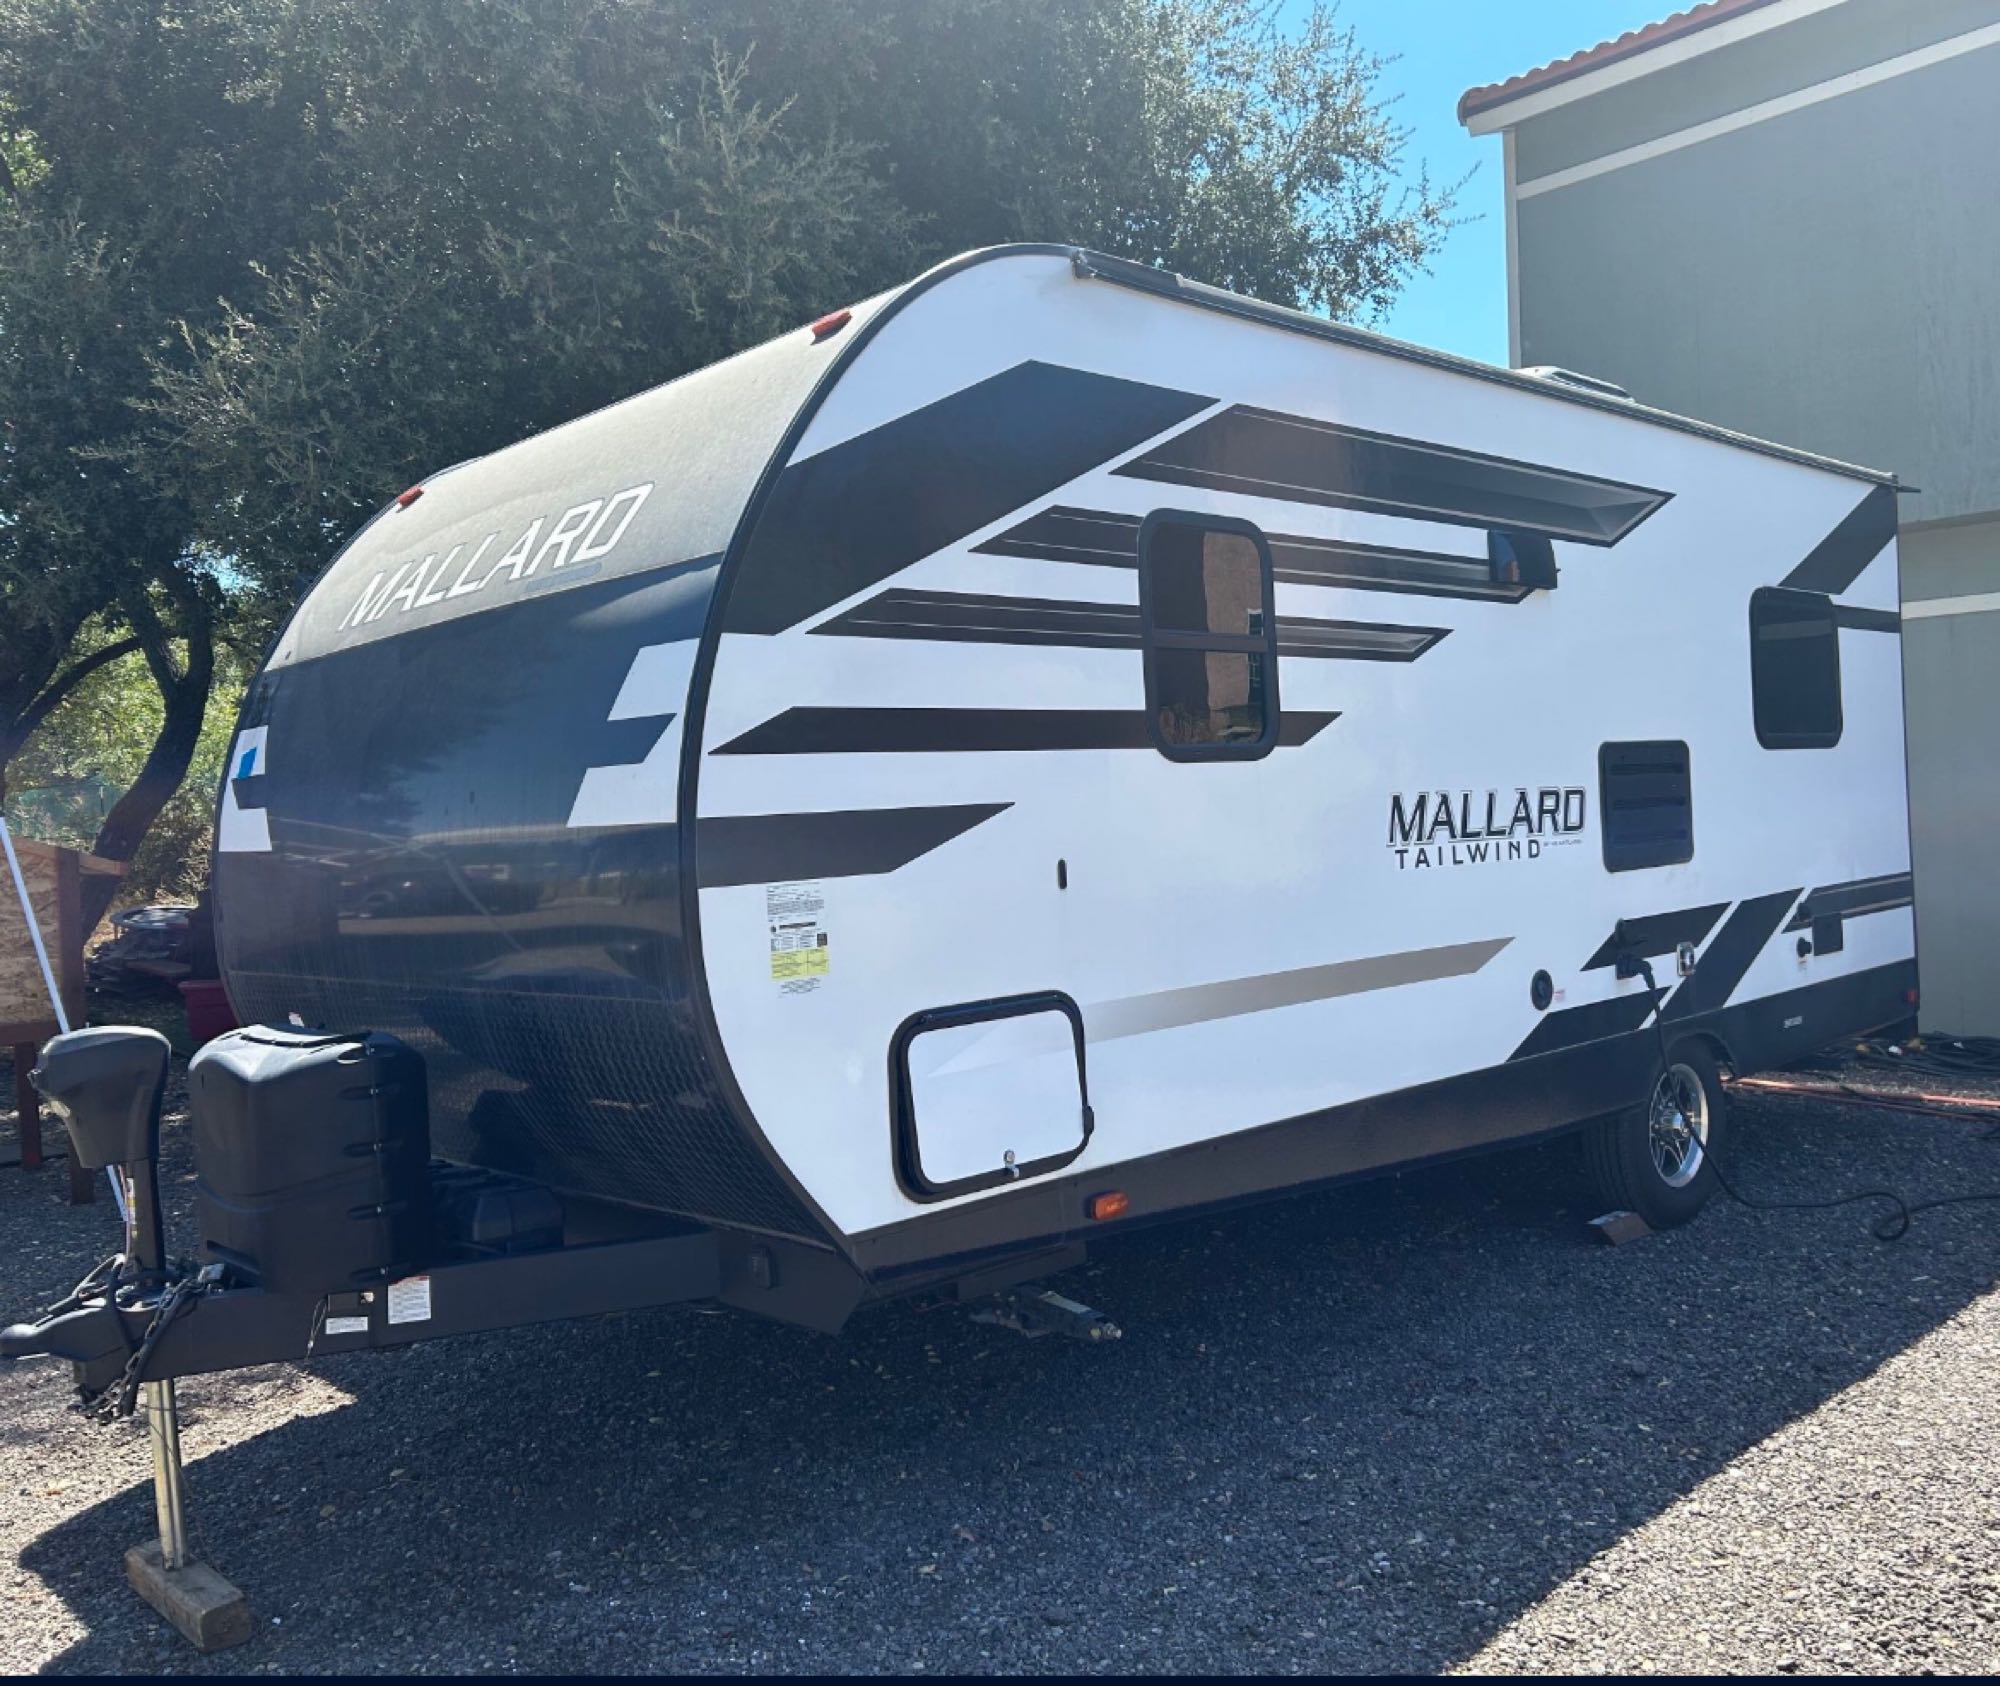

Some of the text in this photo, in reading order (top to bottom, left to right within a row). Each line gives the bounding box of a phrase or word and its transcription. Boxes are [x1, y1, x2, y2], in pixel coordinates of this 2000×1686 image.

[337, 482, 655, 632] MALLARD
[1386, 786, 1586, 847] MALLARD
[1394, 839, 1541, 870] TAILWIND
